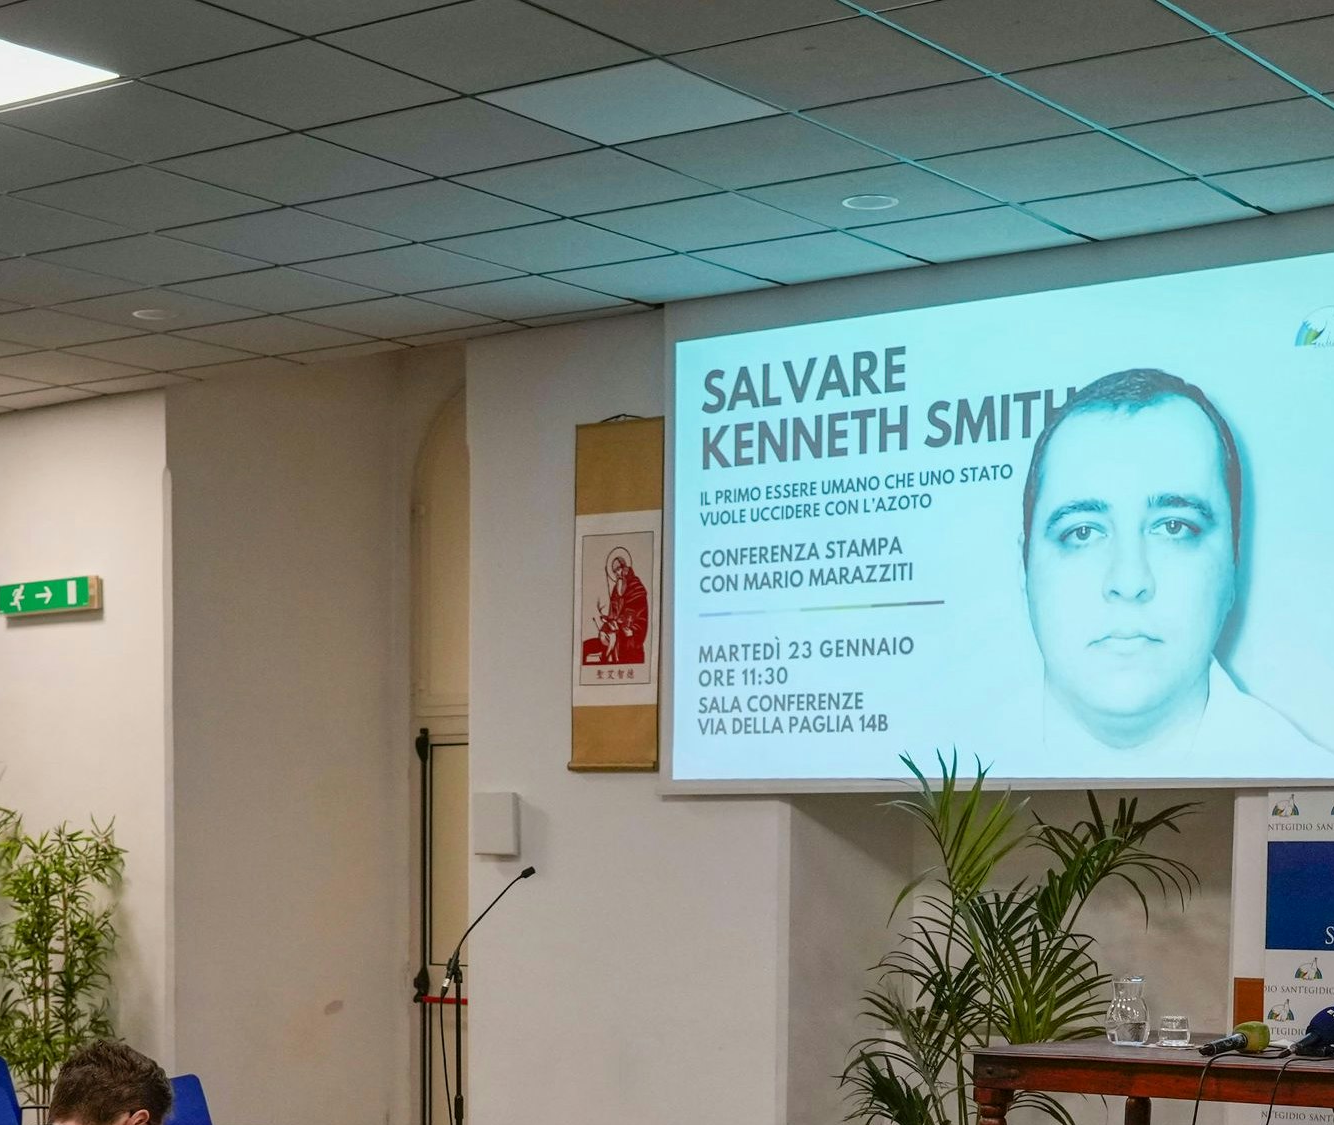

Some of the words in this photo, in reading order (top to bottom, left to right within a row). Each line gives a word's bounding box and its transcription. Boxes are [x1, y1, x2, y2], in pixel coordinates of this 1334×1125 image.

[702, 346, 906, 414] SALVARE
[702, 405, 908, 470] KENNETH
[700, 491, 711, 506] IL
[715, 487, 761, 504] PRIMO
[766, 481, 817, 500] ESSERE
[821, 476, 880, 495] UMANO
[884, 473, 914, 490] CHE
[919, 469, 955, 487] UNO
[960, 464, 1013, 483] STATO
[700, 508, 746, 526] VUOLE
[750, 503, 820, 522] UCCIDERE
[825, 499, 859, 516] CON
[863, 493, 932, 513] L'AZOTO
[700, 542, 820, 568] CONFERENZA
[825, 536, 903, 560] STAMPA
[700, 574, 738, 593] CON
[744, 570, 803, 591] MARIO
[809, 562, 913, 587] MARAZZITI
[699, 636, 781, 663] MARTEDÌ
[788, 641, 812, 660] 23
[820, 636, 914, 658] GENNAIO
[699, 669, 735, 687] ORE
[741, 667, 788, 686] 11:30
[698, 696, 742, 714] SALA
[747, 692, 864, 713] CONFERENZE
[698, 718, 727, 735] VIA
[732, 716, 783, 735] DELLA
[789, 714, 854, 734] PAGLIA
[859, 714, 888, 732] 14B
